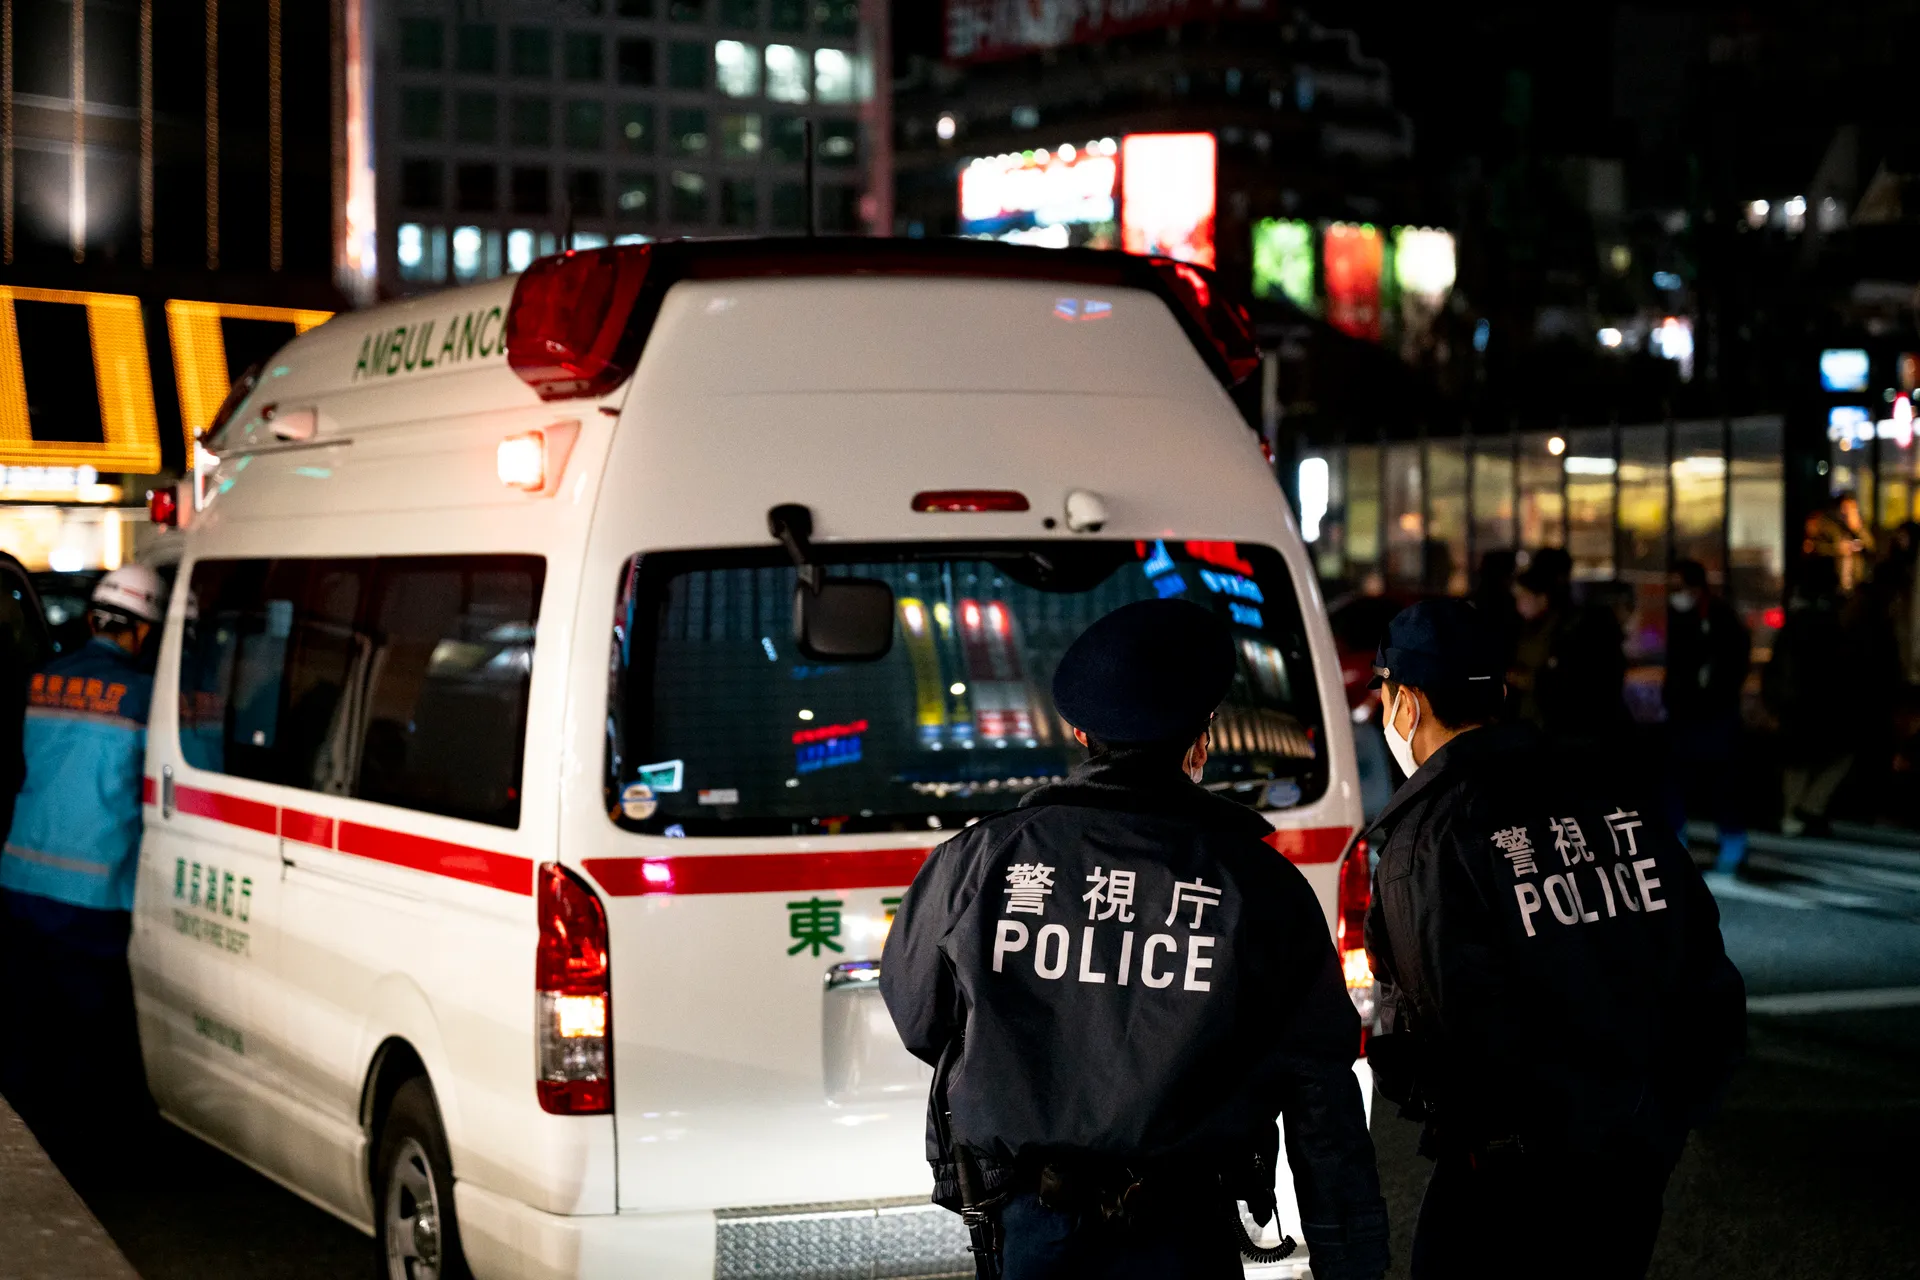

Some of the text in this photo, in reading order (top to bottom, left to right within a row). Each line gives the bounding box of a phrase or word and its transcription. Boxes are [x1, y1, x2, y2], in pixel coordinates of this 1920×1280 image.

[1490, 806, 1643, 878] 警視庁
[1003, 862, 1222, 930] 警視庁
[1514, 857, 1667, 937] POLICE
[992, 919, 1216, 992] POLICE
